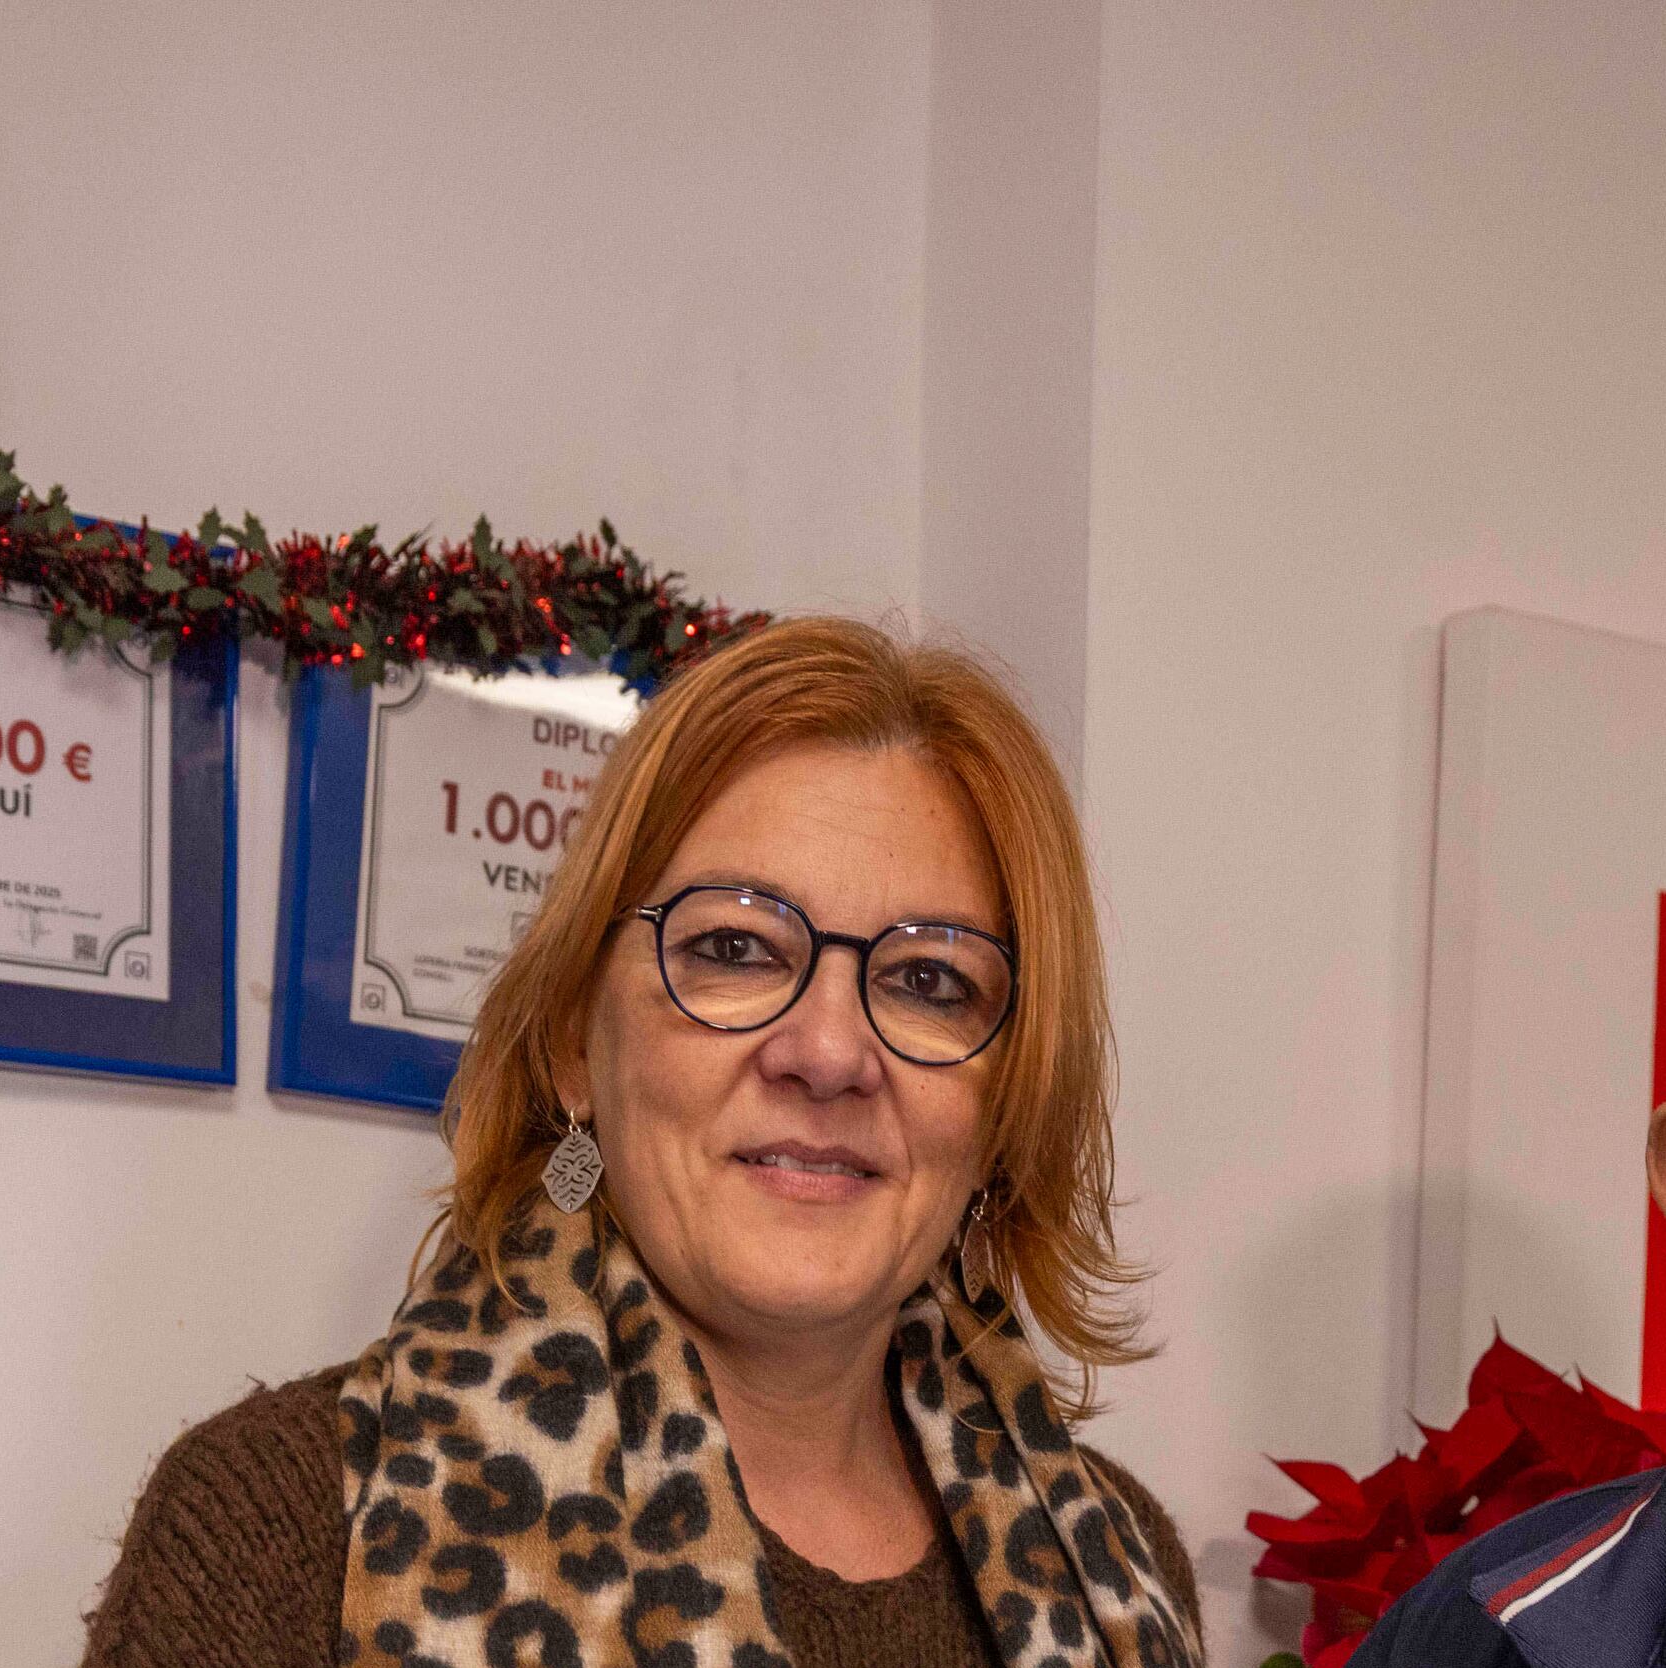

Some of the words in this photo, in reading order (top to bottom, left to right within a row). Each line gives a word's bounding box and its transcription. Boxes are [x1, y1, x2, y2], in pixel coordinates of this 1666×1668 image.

[532, 716, 618, 757] DIPLO
[62, 741, 94, 783] €
[541, 768, 567, 791] EL
